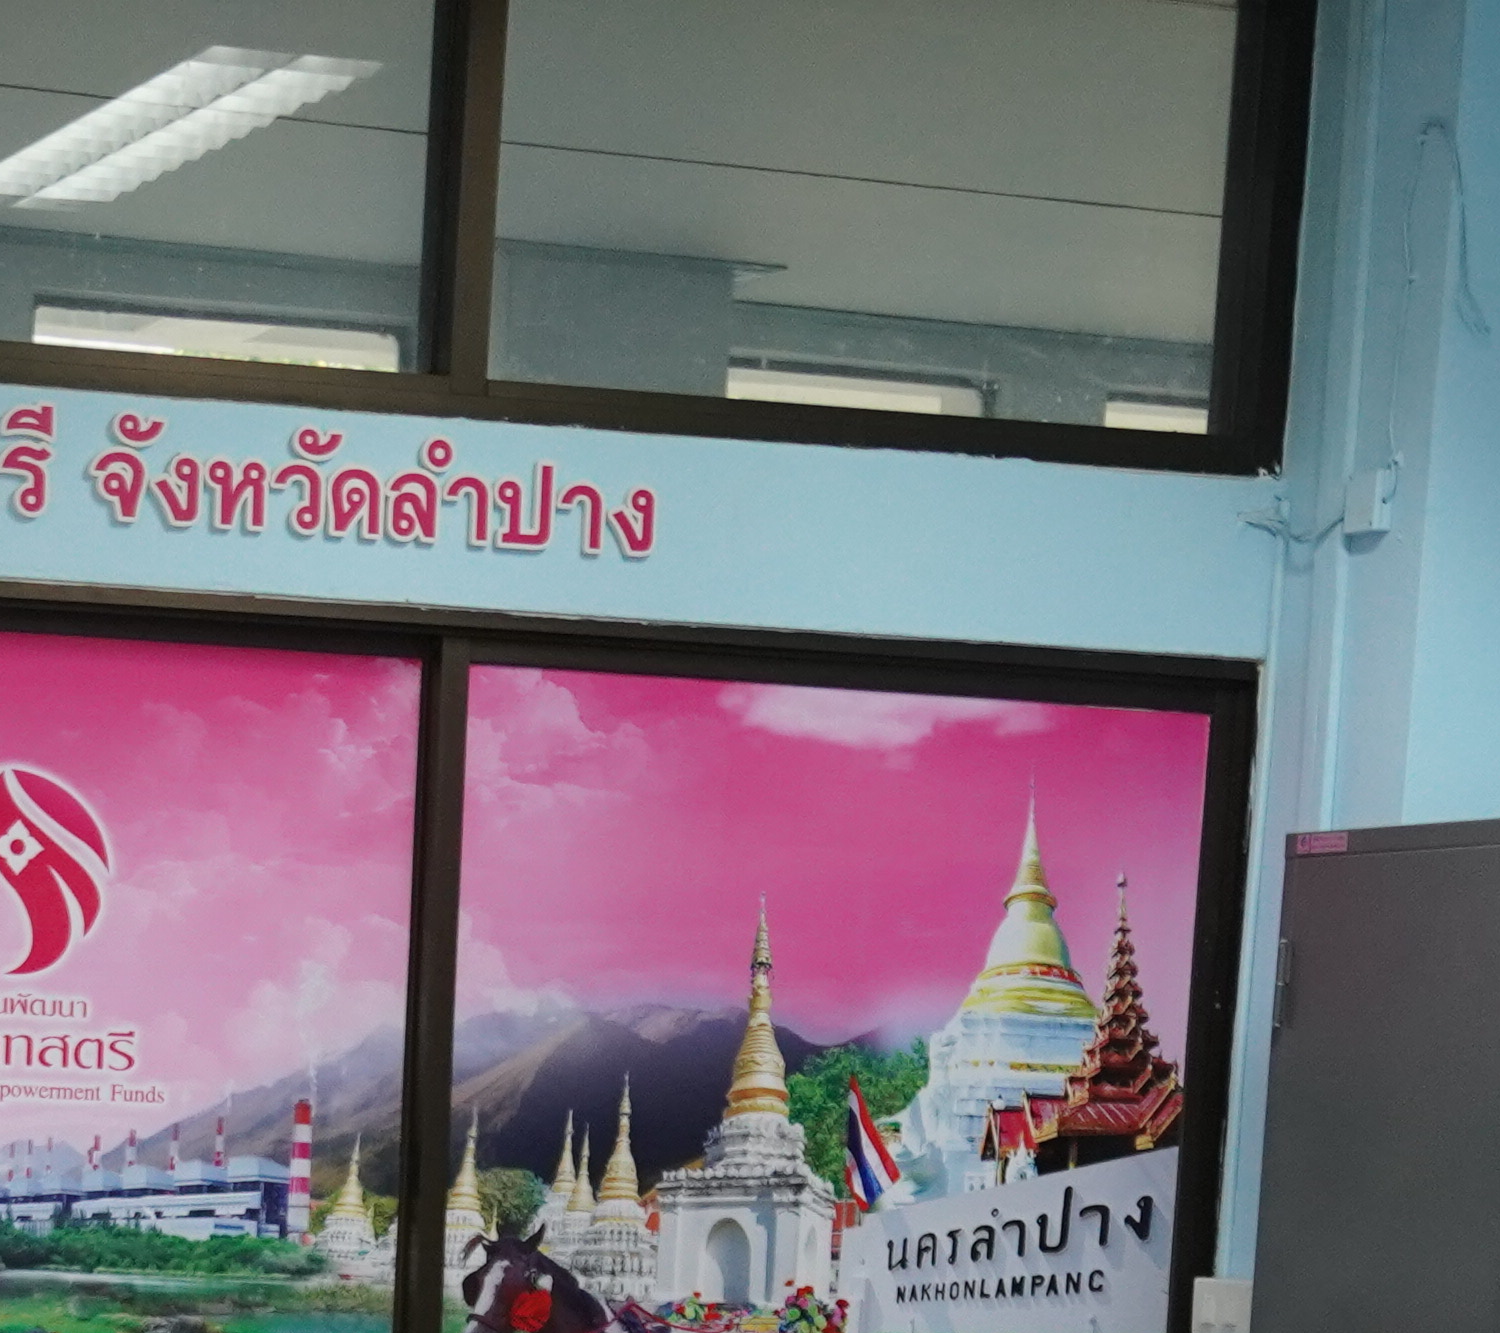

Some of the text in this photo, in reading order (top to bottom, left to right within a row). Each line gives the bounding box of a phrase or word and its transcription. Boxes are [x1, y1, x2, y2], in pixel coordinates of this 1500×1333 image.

[96, 415, 655, 551] จังหวัดลำปาง
[110, 1083, 166, 1105] Funds
[886, 1186, 1154, 1271] นครลำปาง
